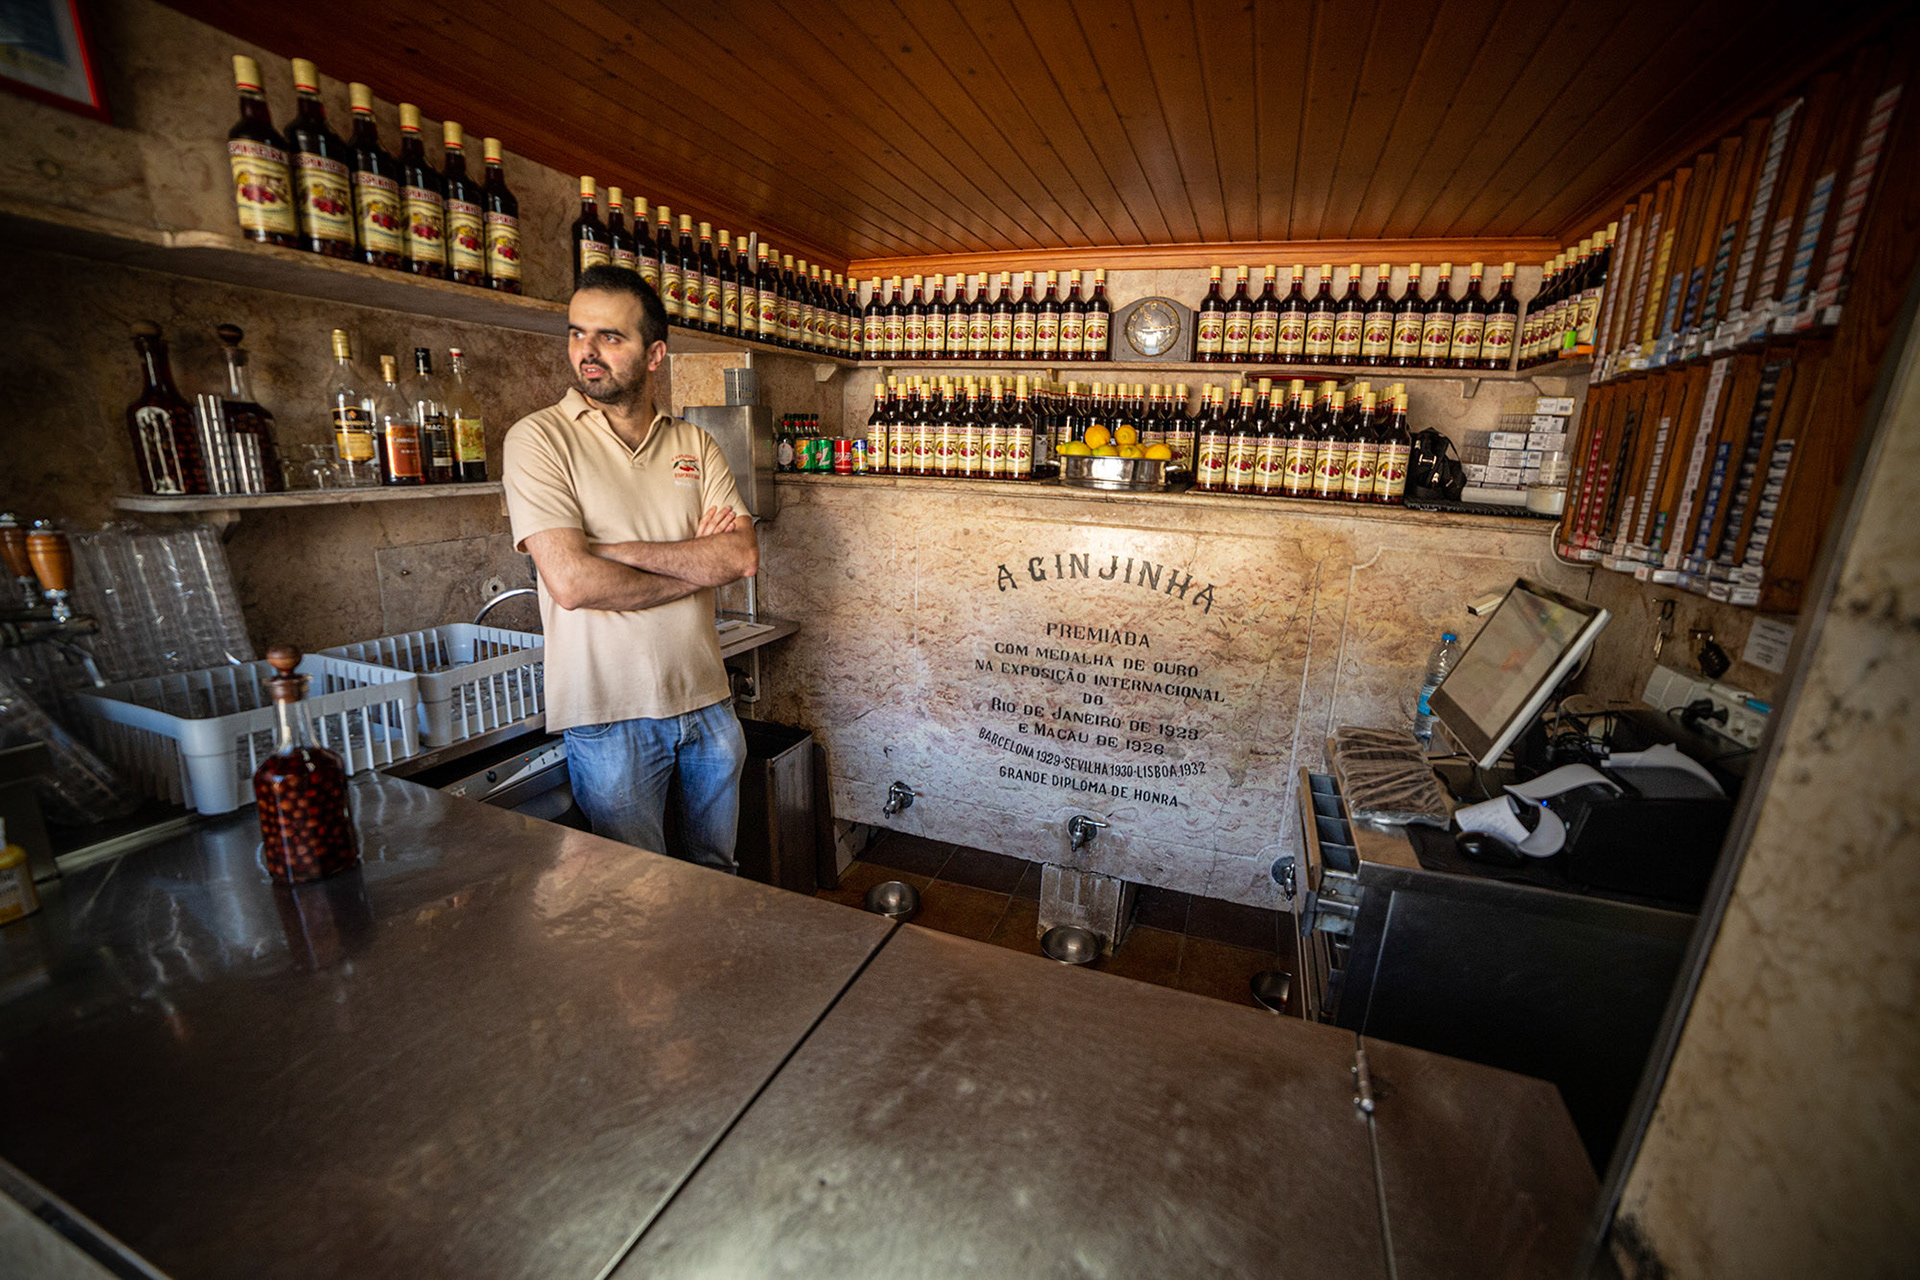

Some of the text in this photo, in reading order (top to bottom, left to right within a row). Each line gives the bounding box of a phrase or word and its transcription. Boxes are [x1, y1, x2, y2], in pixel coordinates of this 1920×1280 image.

[997, 553, 1216, 614] A GINJINHA
[1046, 622, 1150, 648] PREMIADA
[994, 642, 1199, 678] COM MEDALHA DE OURO
[975, 659, 1225, 703] NA EXPOSIÇÃO INTERNACIONAL
[1082, 692, 1104, 706] DO
[1023, 704, 1045, 718] DE
[1129, 720, 1152, 733] DE
[978, 727, 1034, 759] BARCELONA
[1018, 722, 1029, 734] E
[1096, 735, 1118, 748] DE
[1126, 740, 1165, 756] 1926
[999, 765, 1178, 807] GRANDE DIPLOMA DE HONRA
